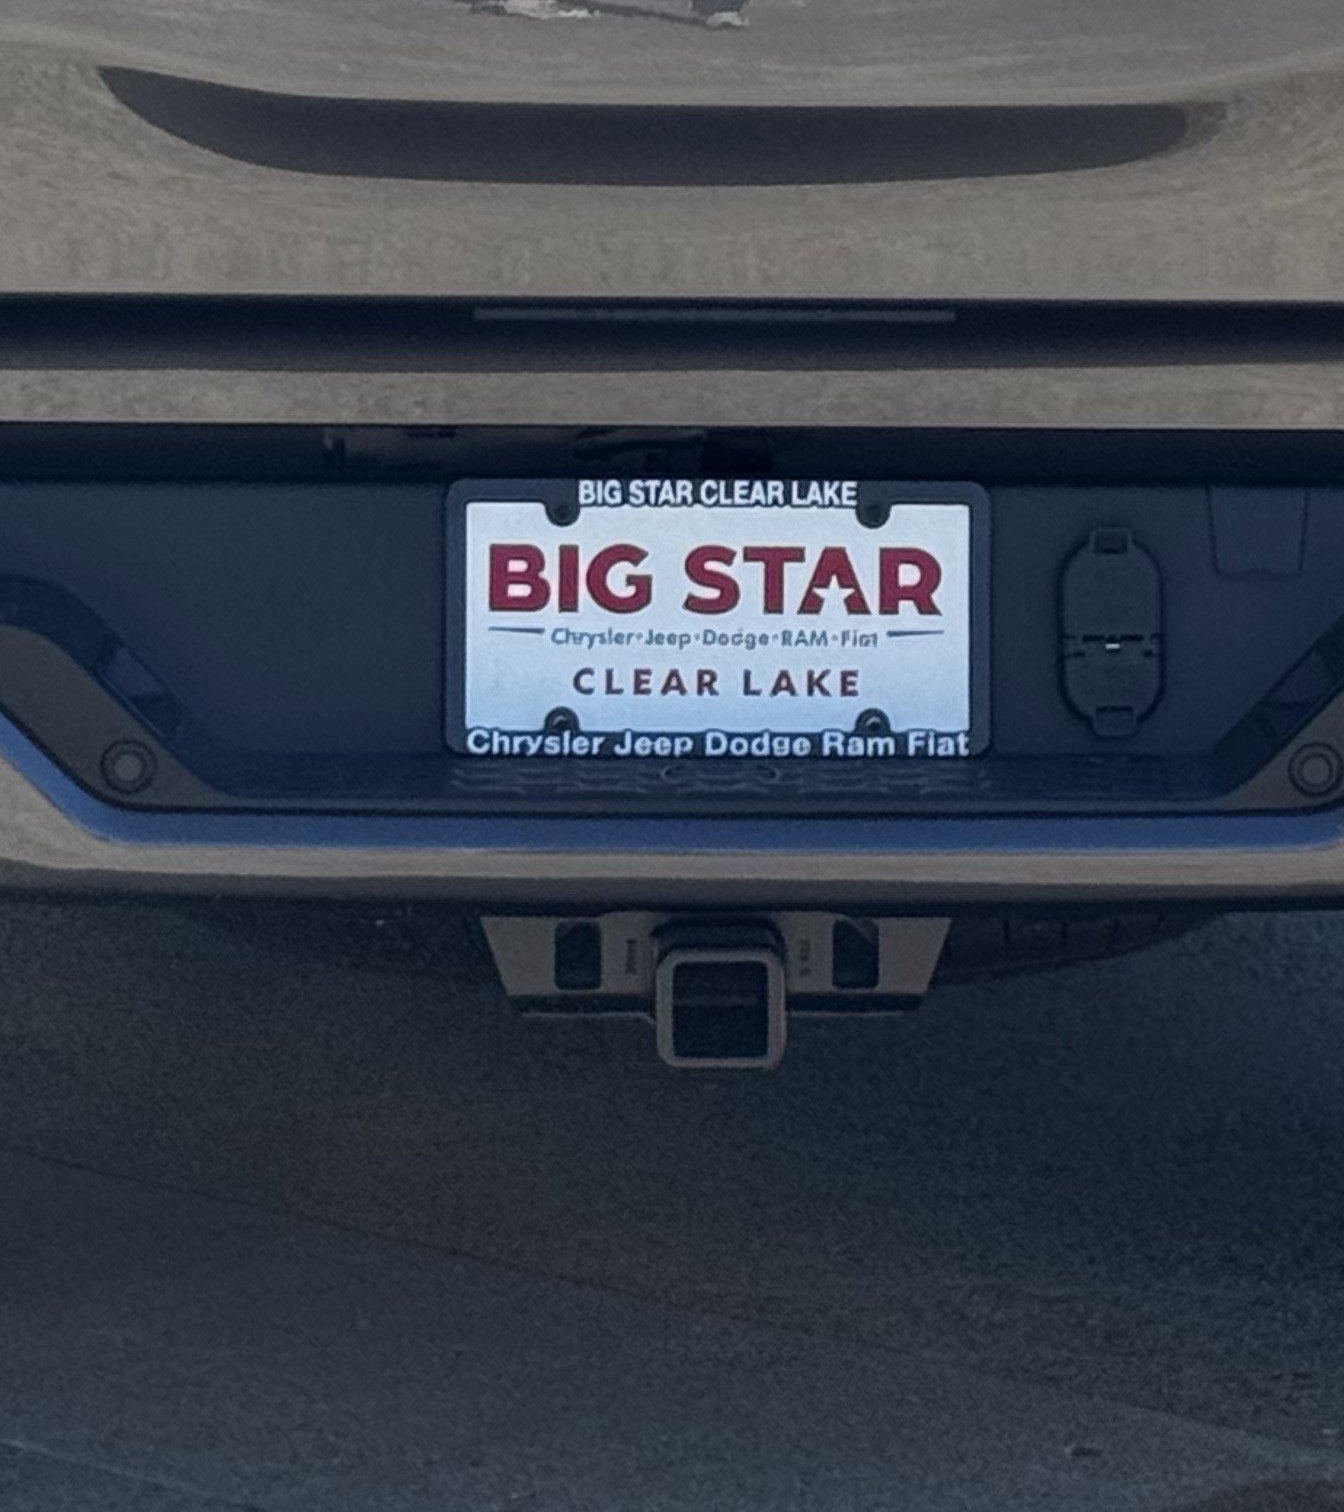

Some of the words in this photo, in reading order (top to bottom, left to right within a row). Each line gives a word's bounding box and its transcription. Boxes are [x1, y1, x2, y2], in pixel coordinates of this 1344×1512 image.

[578, 479, 622, 505] BIG
[629, 480, 693, 506] STAR
[700, 480, 785, 506] CLEAR
[792, 481, 858, 506] LAKE
[488, 543, 653, 614] BIG
[682, 544, 942, 615] STAR
[572, 667, 719, 696] CLEAR
[742, 669, 859, 697] LAKE
[467, 727, 606, 756] Chrysler
[613, 730, 693, 758] Jeep
[705, 731, 811, 758] Dodge
[822, 732, 895, 757] Ram
[907, 731, 969, 757] Fiat
